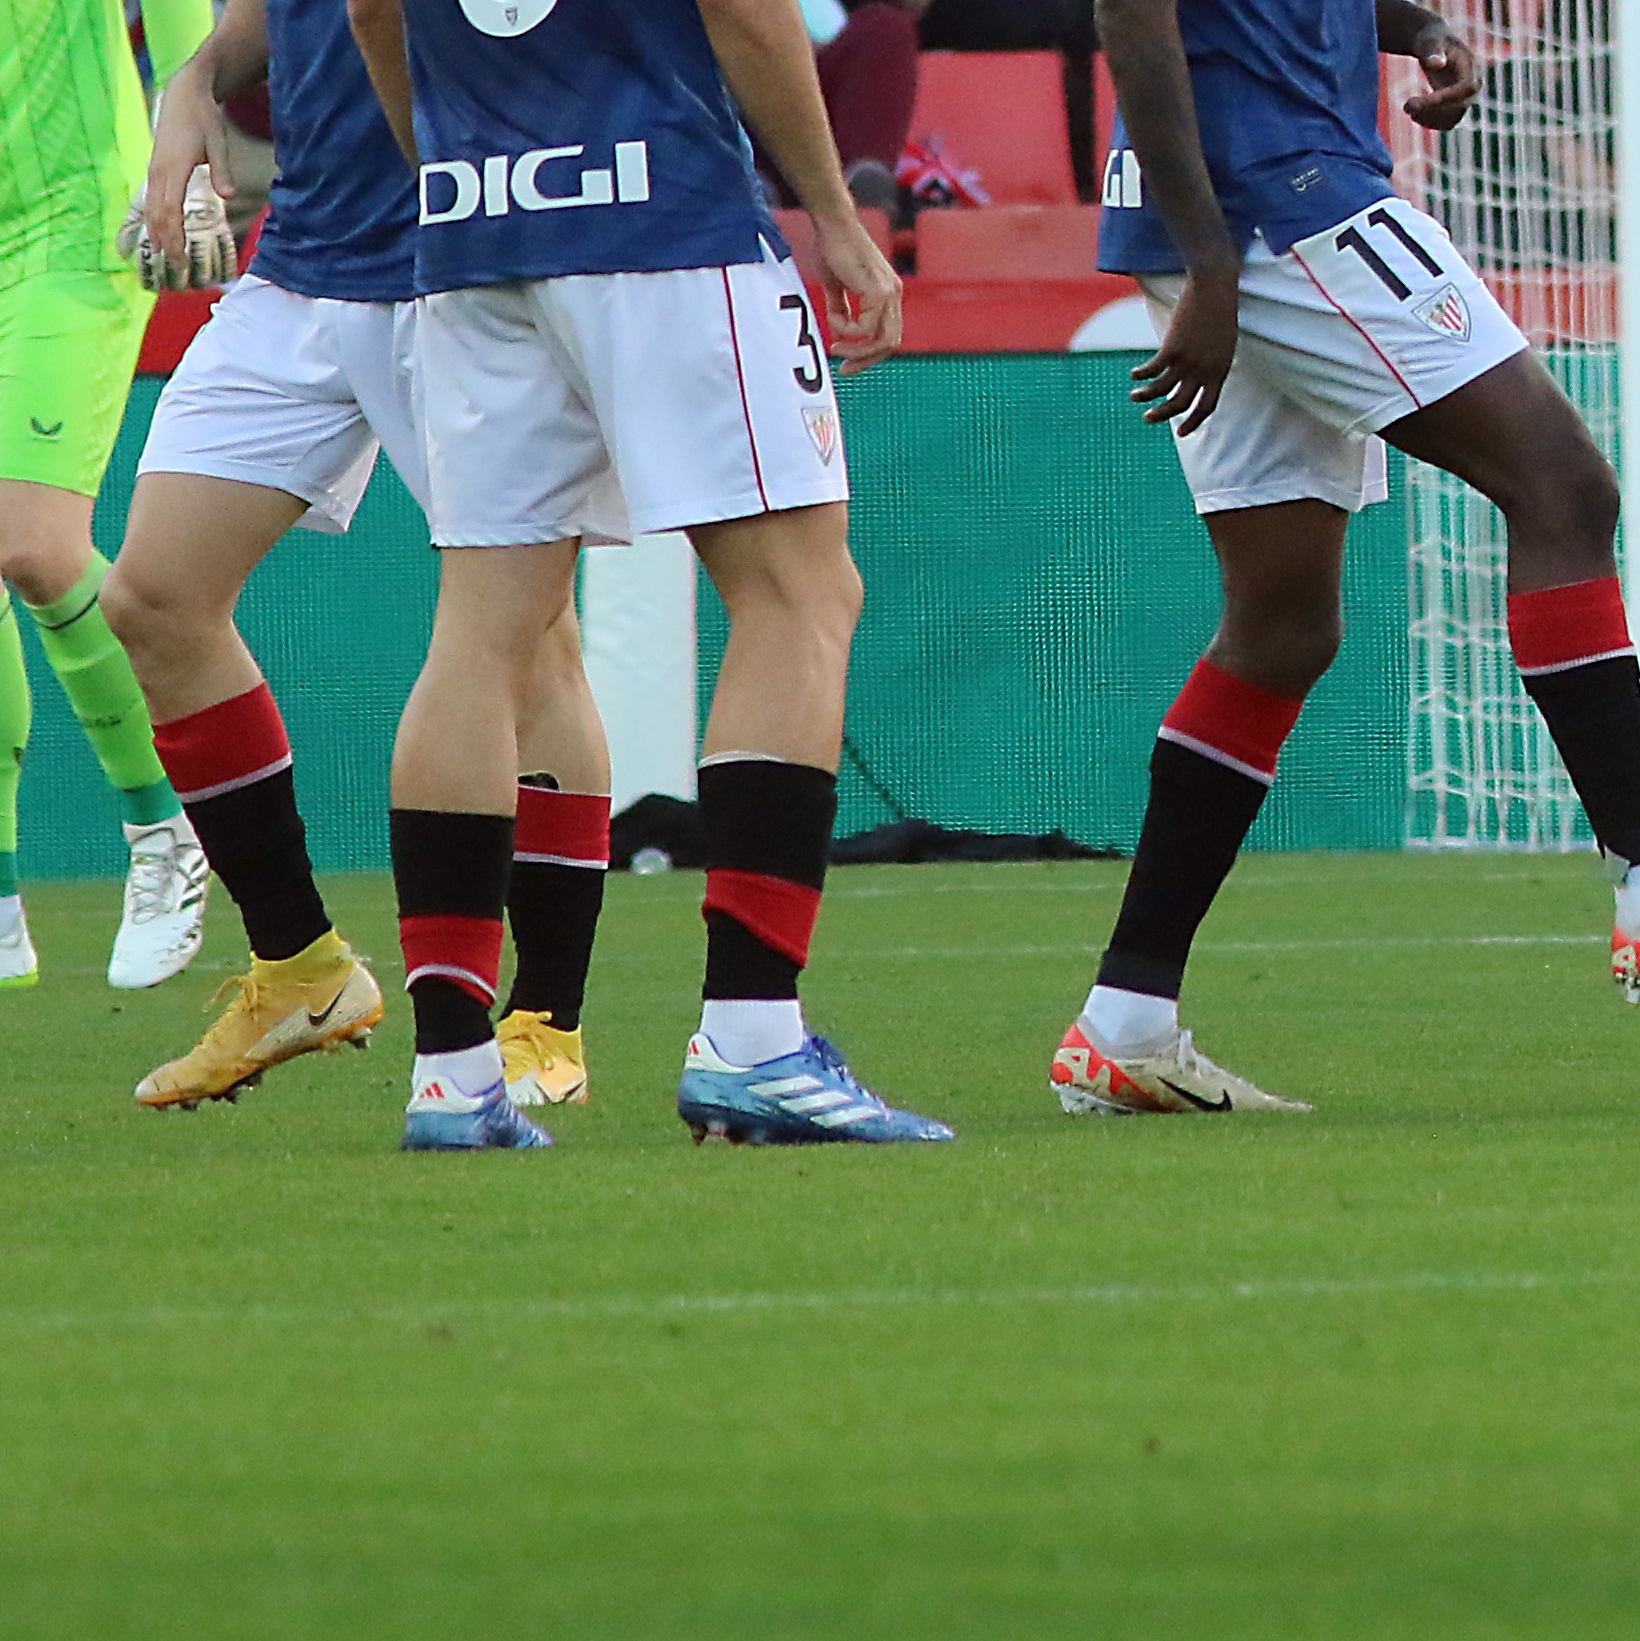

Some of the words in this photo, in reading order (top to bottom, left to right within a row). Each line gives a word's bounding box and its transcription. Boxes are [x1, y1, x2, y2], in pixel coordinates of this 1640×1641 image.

[419, 140, 650, 226] DIGI
[1334, 207, 1444, 302] 11
[779, 294, 823, 394] 3
